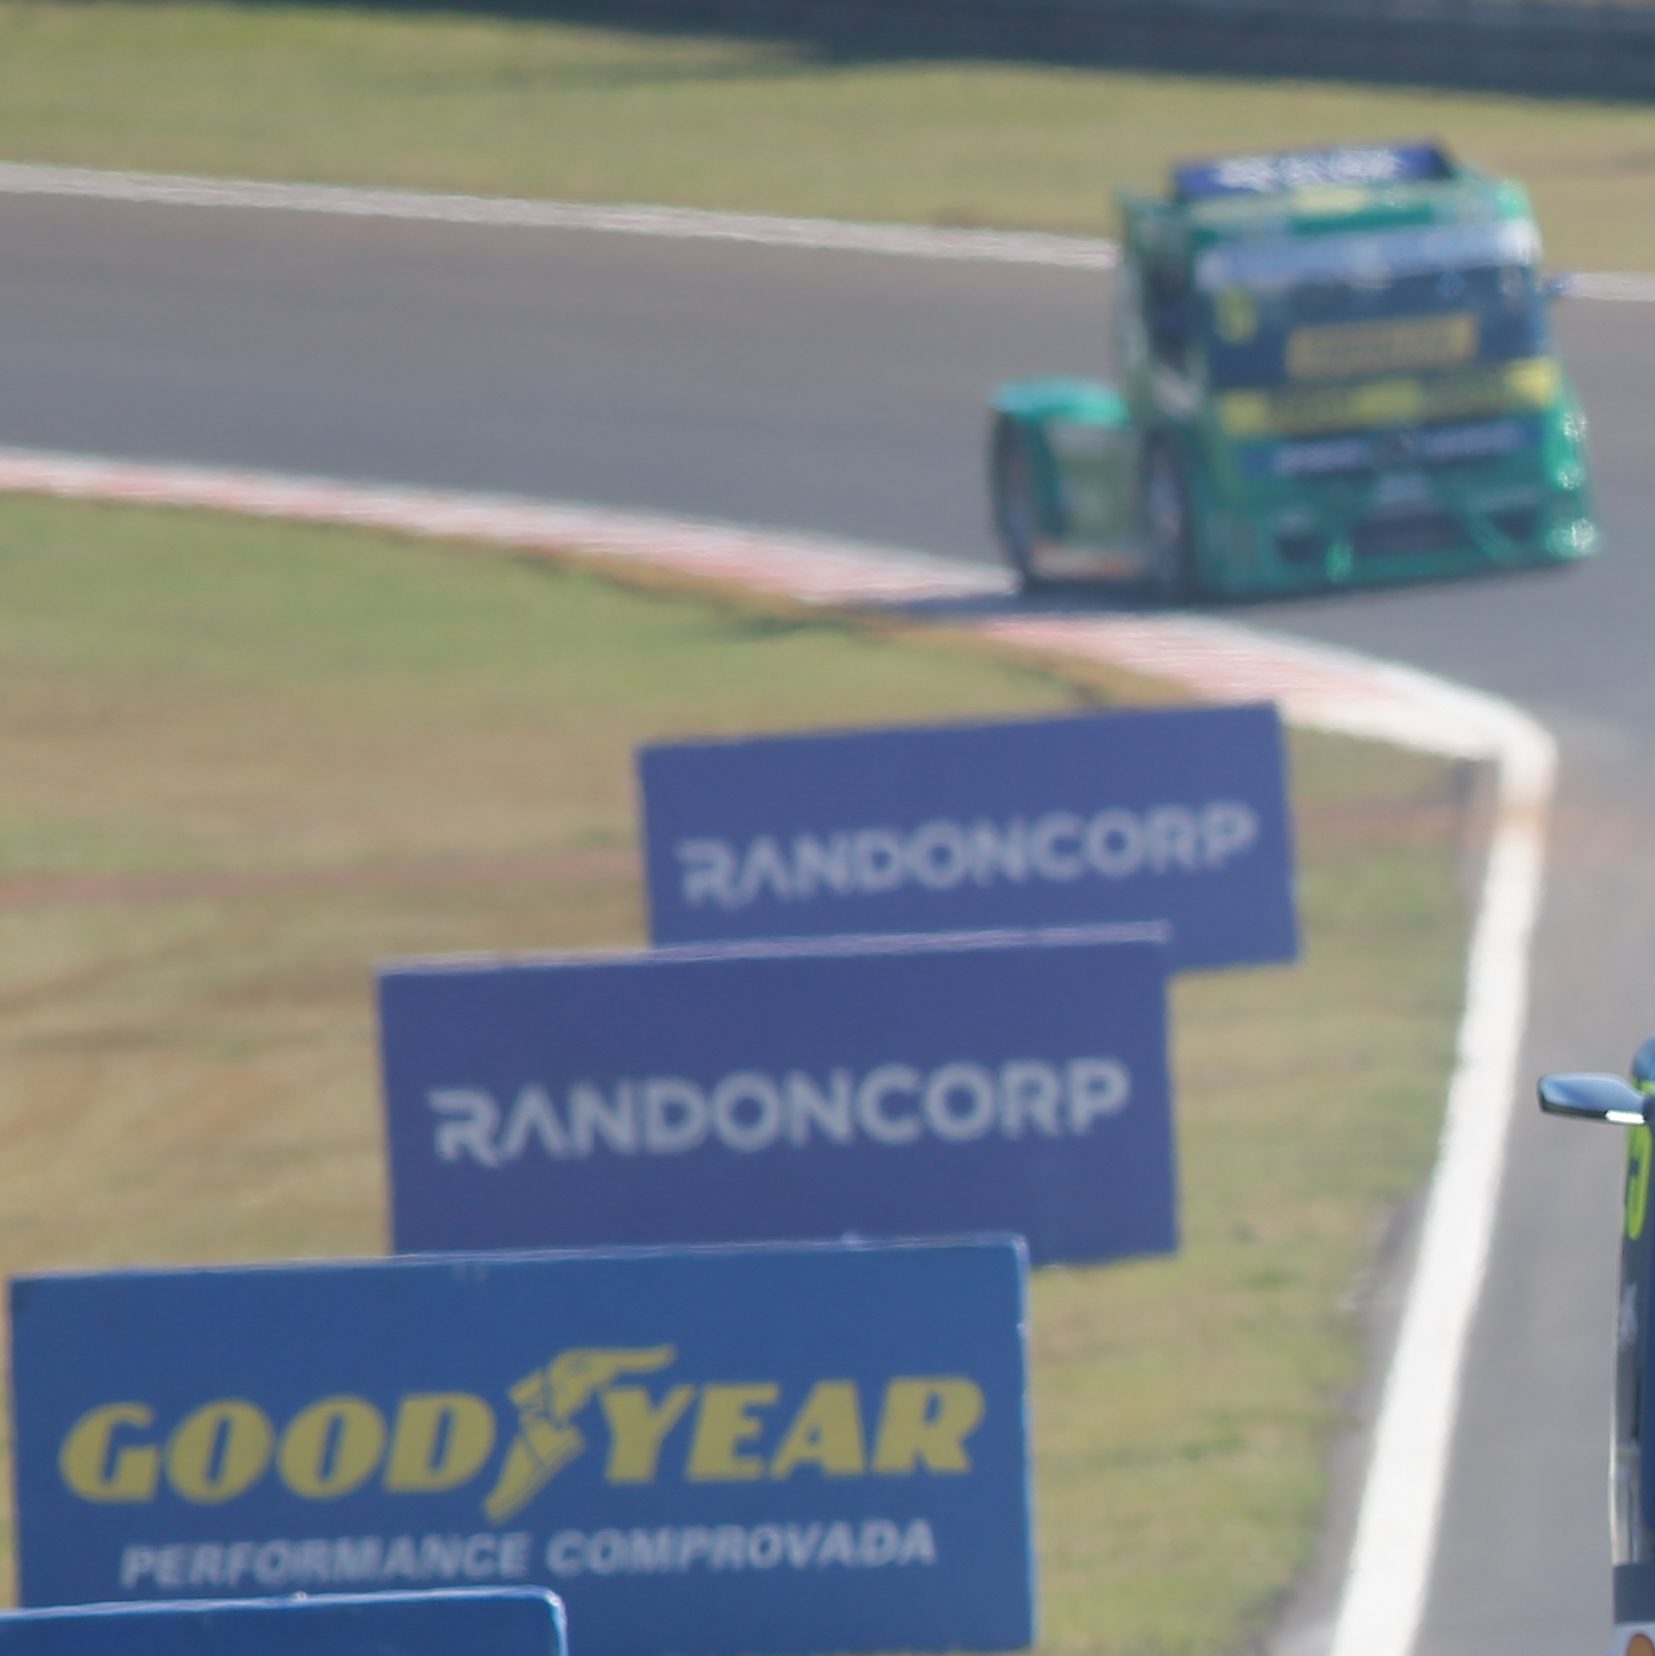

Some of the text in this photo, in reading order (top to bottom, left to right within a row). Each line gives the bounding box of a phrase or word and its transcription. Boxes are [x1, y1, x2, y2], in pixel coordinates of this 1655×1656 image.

[676, 800, 1260, 910] RANDONCORP
[427, 1056, 1132, 1167] RANDONCORP
[120, 1520, 936, 1588] PERFORMANCE COMPROVADA
